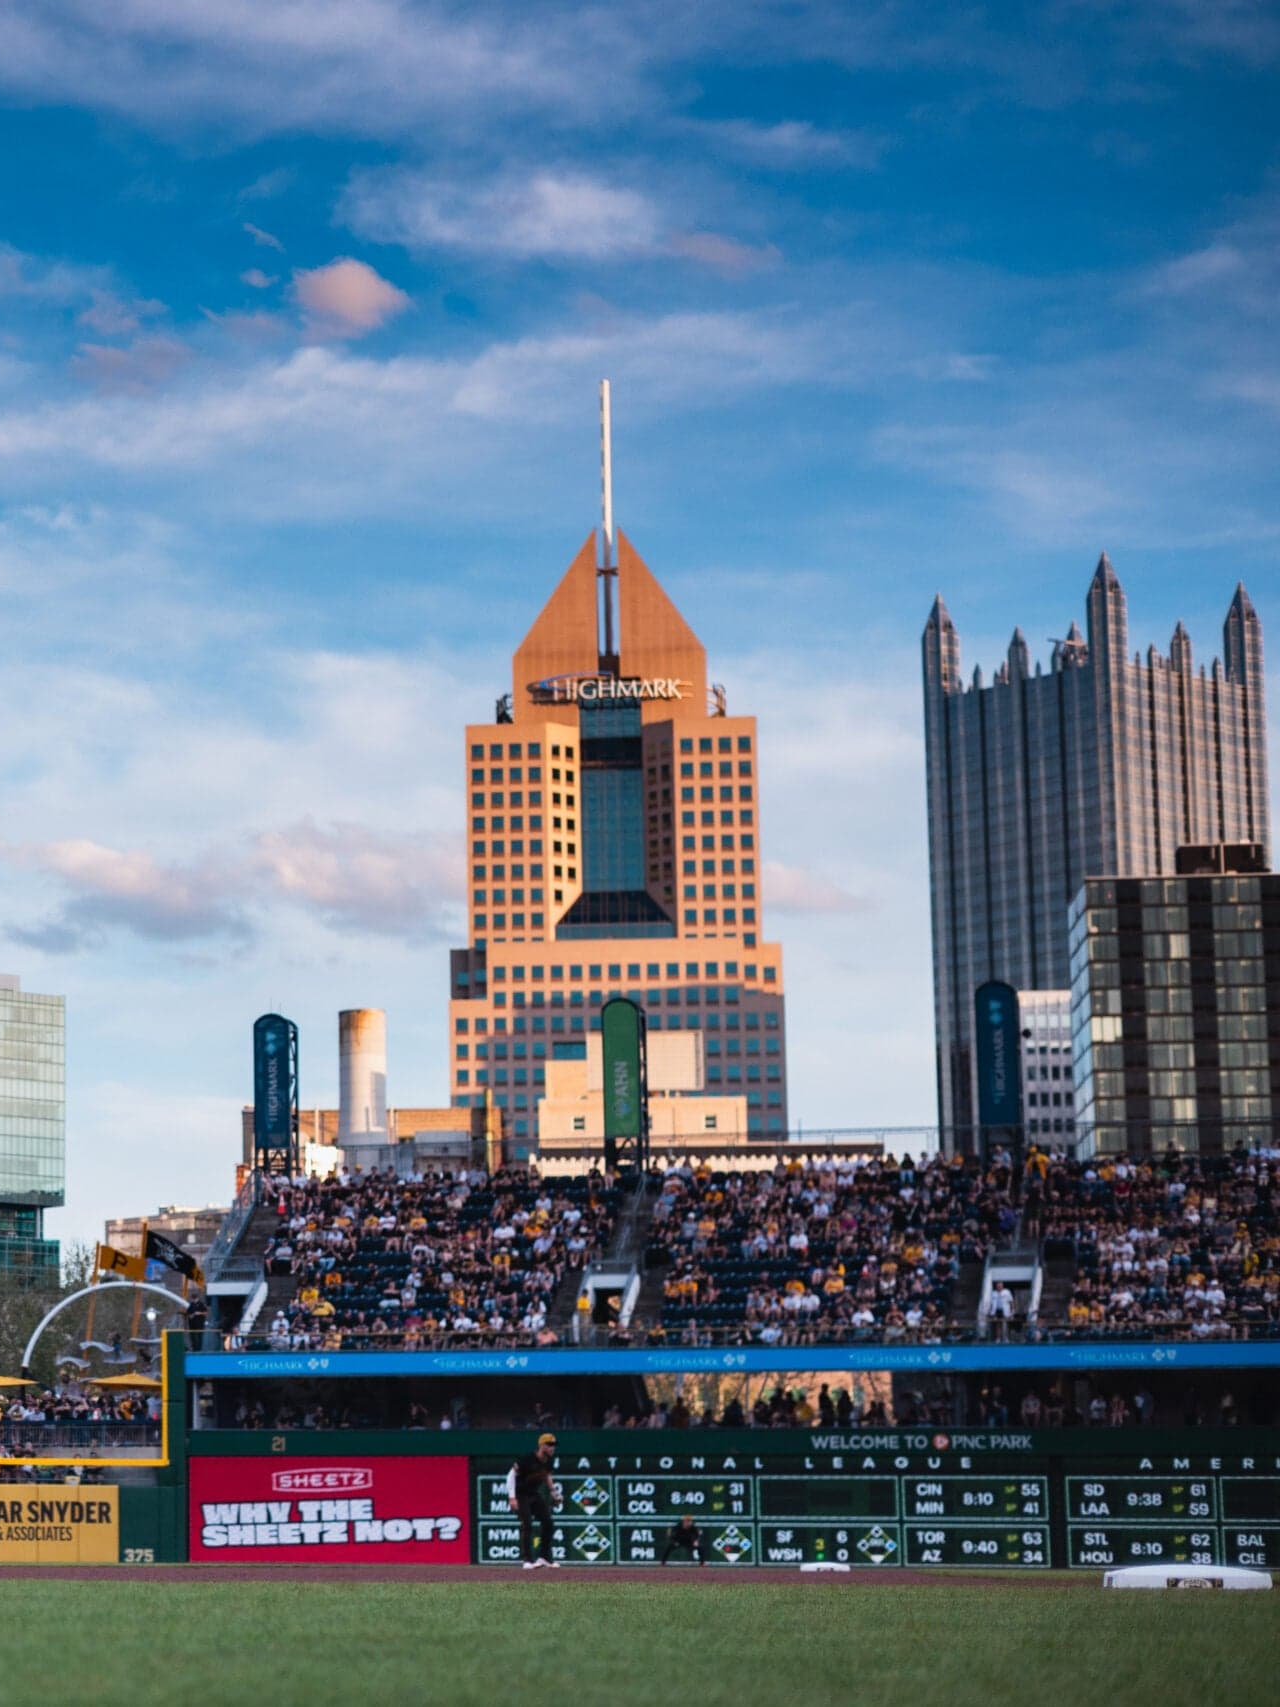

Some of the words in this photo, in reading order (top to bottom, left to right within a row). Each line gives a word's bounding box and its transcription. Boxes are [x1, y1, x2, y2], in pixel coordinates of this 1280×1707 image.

[553, 678, 682, 699] HIGHMARK
[111, 1250, 128, 1270] P
[811, 1434, 900, 1449] WELCOME
[904, 1434, 928, 1449] TO
[951, 1434, 987, 1449] PNC
[990, 1434, 1033, 1449] PARK
[805, 1456, 971, 1470] LEAGUE
[279, 1472, 366, 1488] SHEETZ
[628, 1482, 655, 1496] LAD
[729, 1482, 744, 1496] 31
[916, 1483, 942, 1496] CIN
[1021, 1483, 1040, 1497] 55
[1083, 1484, 1105, 1497] SD
[1190, 1484, 1207, 1497] 61
[671, 1491, 704, 1505] 8:40
[963, 1492, 994, 1506] 8:10
[1127, 1493, 1163, 1506] 9:38
[27, 1501, 112, 1525] SNYDER
[201, 1501, 293, 1525] WHY
[297, 1498, 373, 1522] THE
[628, 1500, 656, 1514] COL
[732, 1501, 743, 1514] 11
[916, 1502, 944, 1515] MIN
[1023, 1502, 1039, 1515] 41
[1080, 1502, 1110, 1516] LAA
[1189, 1502, 1209, 1516] 59
[6, 1526, 72, 1542] ASSOCIATES
[201, 1521, 349, 1547] SHEETZ
[353, 1516, 462, 1543] NOT?
[488, 1529, 520, 1541] NYM
[553, 1529, 564, 1541] 4
[631, 1529, 655, 1542] ATL
[776, 1530, 793, 1543] SF
[836, 1530, 848, 1544] 6
[917, 1531, 946, 1544] TOR
[1022, 1532, 1042, 1545] 63
[1084, 1532, 1109, 1546] STL
[1191, 1533, 1211, 1547] 62
[1237, 1533, 1266, 1546] BAL
[489, 1546, 520, 1558] CHC
[551, 1547, 565, 1559] 12
[631, 1547, 655, 1559] PHI
[768, 1548, 803, 1560] WSH
[962, 1541, 998, 1554] 9:40
[1131, 1542, 1163, 1556] 8:10
[124, 1549, 154, 1562] 375
[837, 1548, 849, 1561] 0
[922, 1550, 943, 1562] AZ
[1023, 1550, 1043, 1563] 34
[1080, 1551, 1114, 1564] HOU
[1191, 1552, 1212, 1565] 38
[1238, 1552, 1266, 1565] CLE
